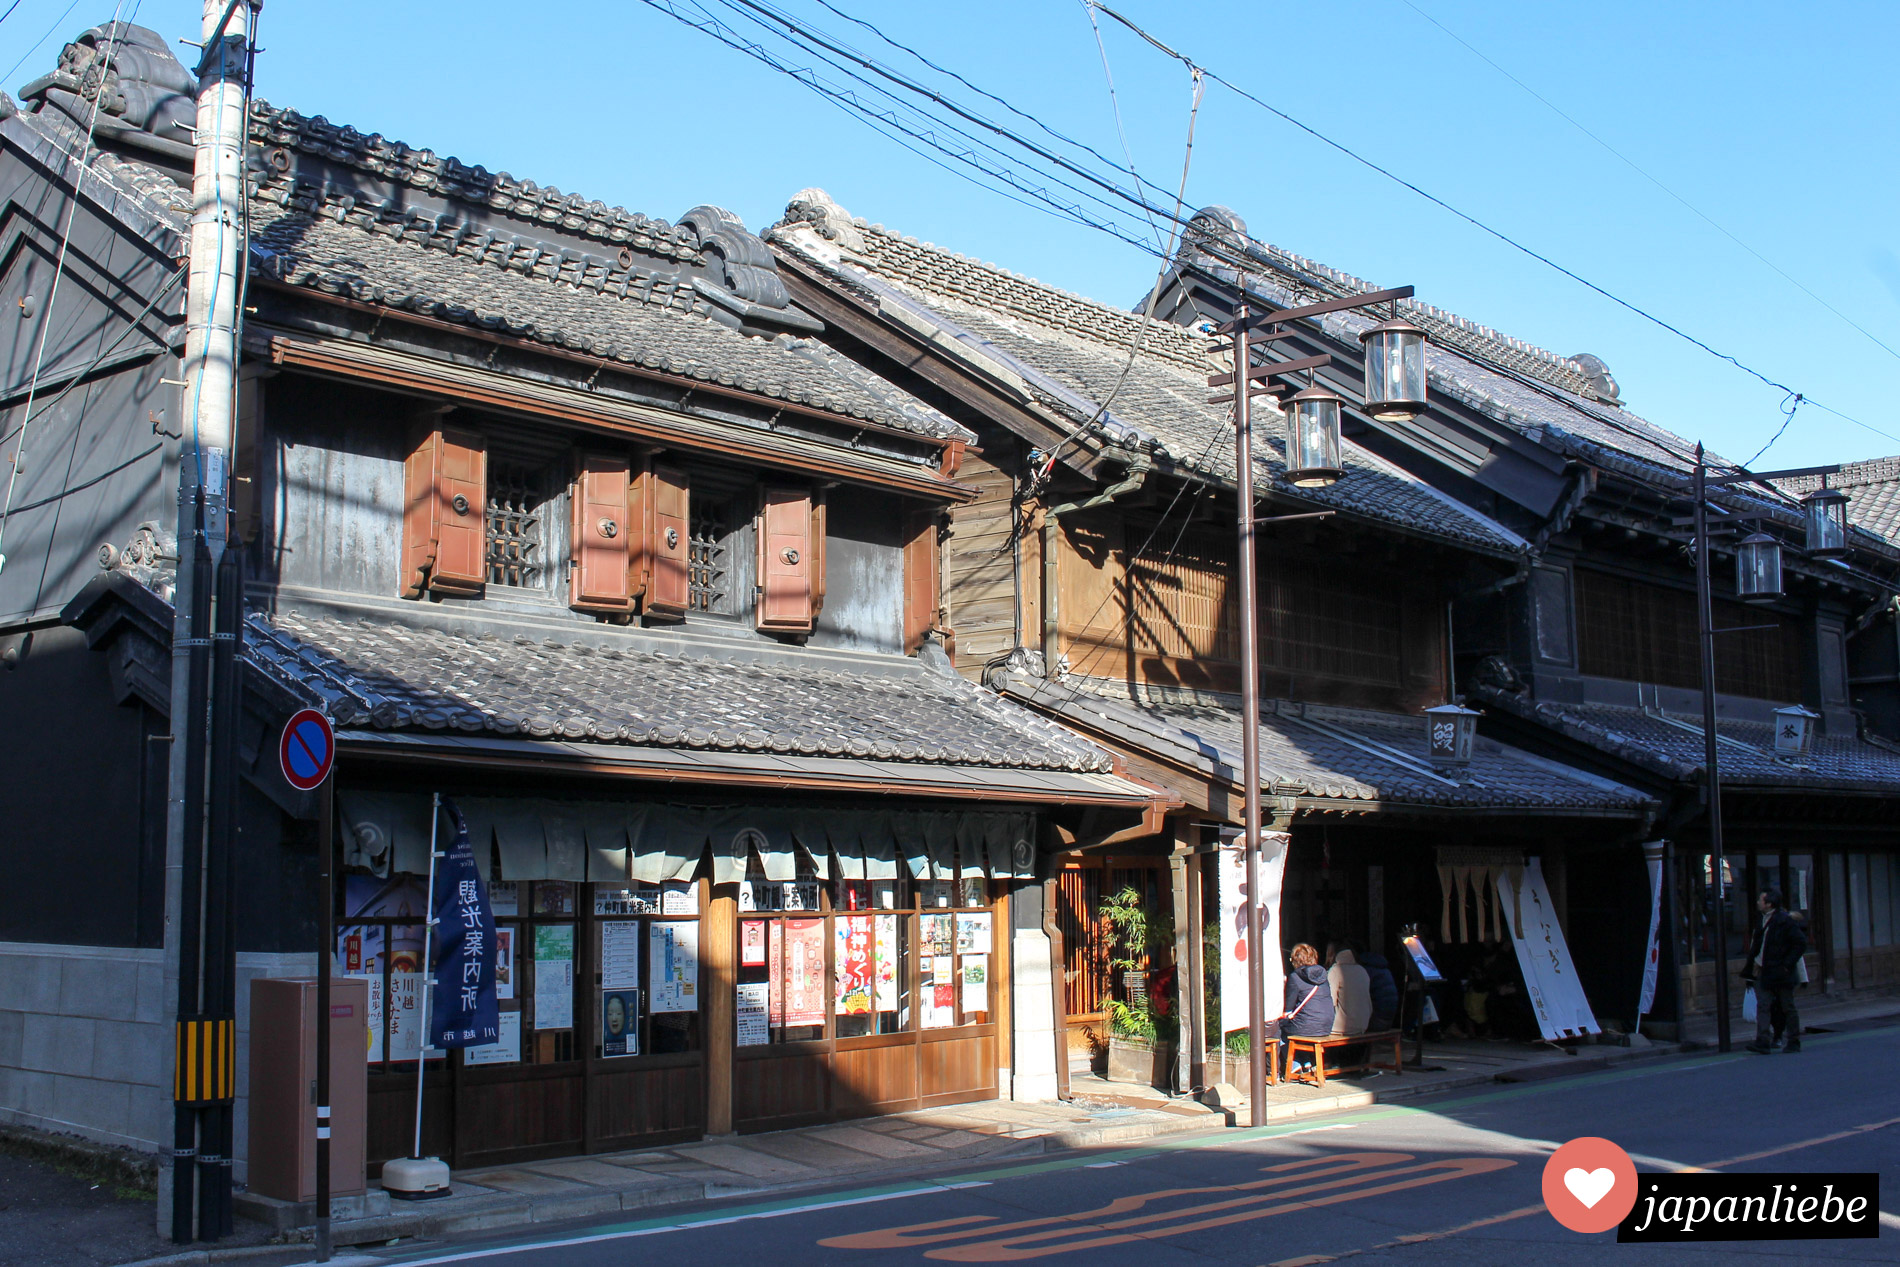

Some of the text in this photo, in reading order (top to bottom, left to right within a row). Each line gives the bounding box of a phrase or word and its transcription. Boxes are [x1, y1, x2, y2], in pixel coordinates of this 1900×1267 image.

[1433, 721, 1455, 752] 鰻
[1779, 724, 1799, 739] 茶
[605, 900, 659, 914] 仲町観光案内所
[753, 884, 817, 910] 仲町観光案内所
[349, 940, 358, 964] 川越
[850, 894, 868, 991] 七福神めぐり
[371, 979, 381, 1010] お散歩
[389, 978, 401, 1035] さいたま
[402, 978, 414, 1010] 川越
